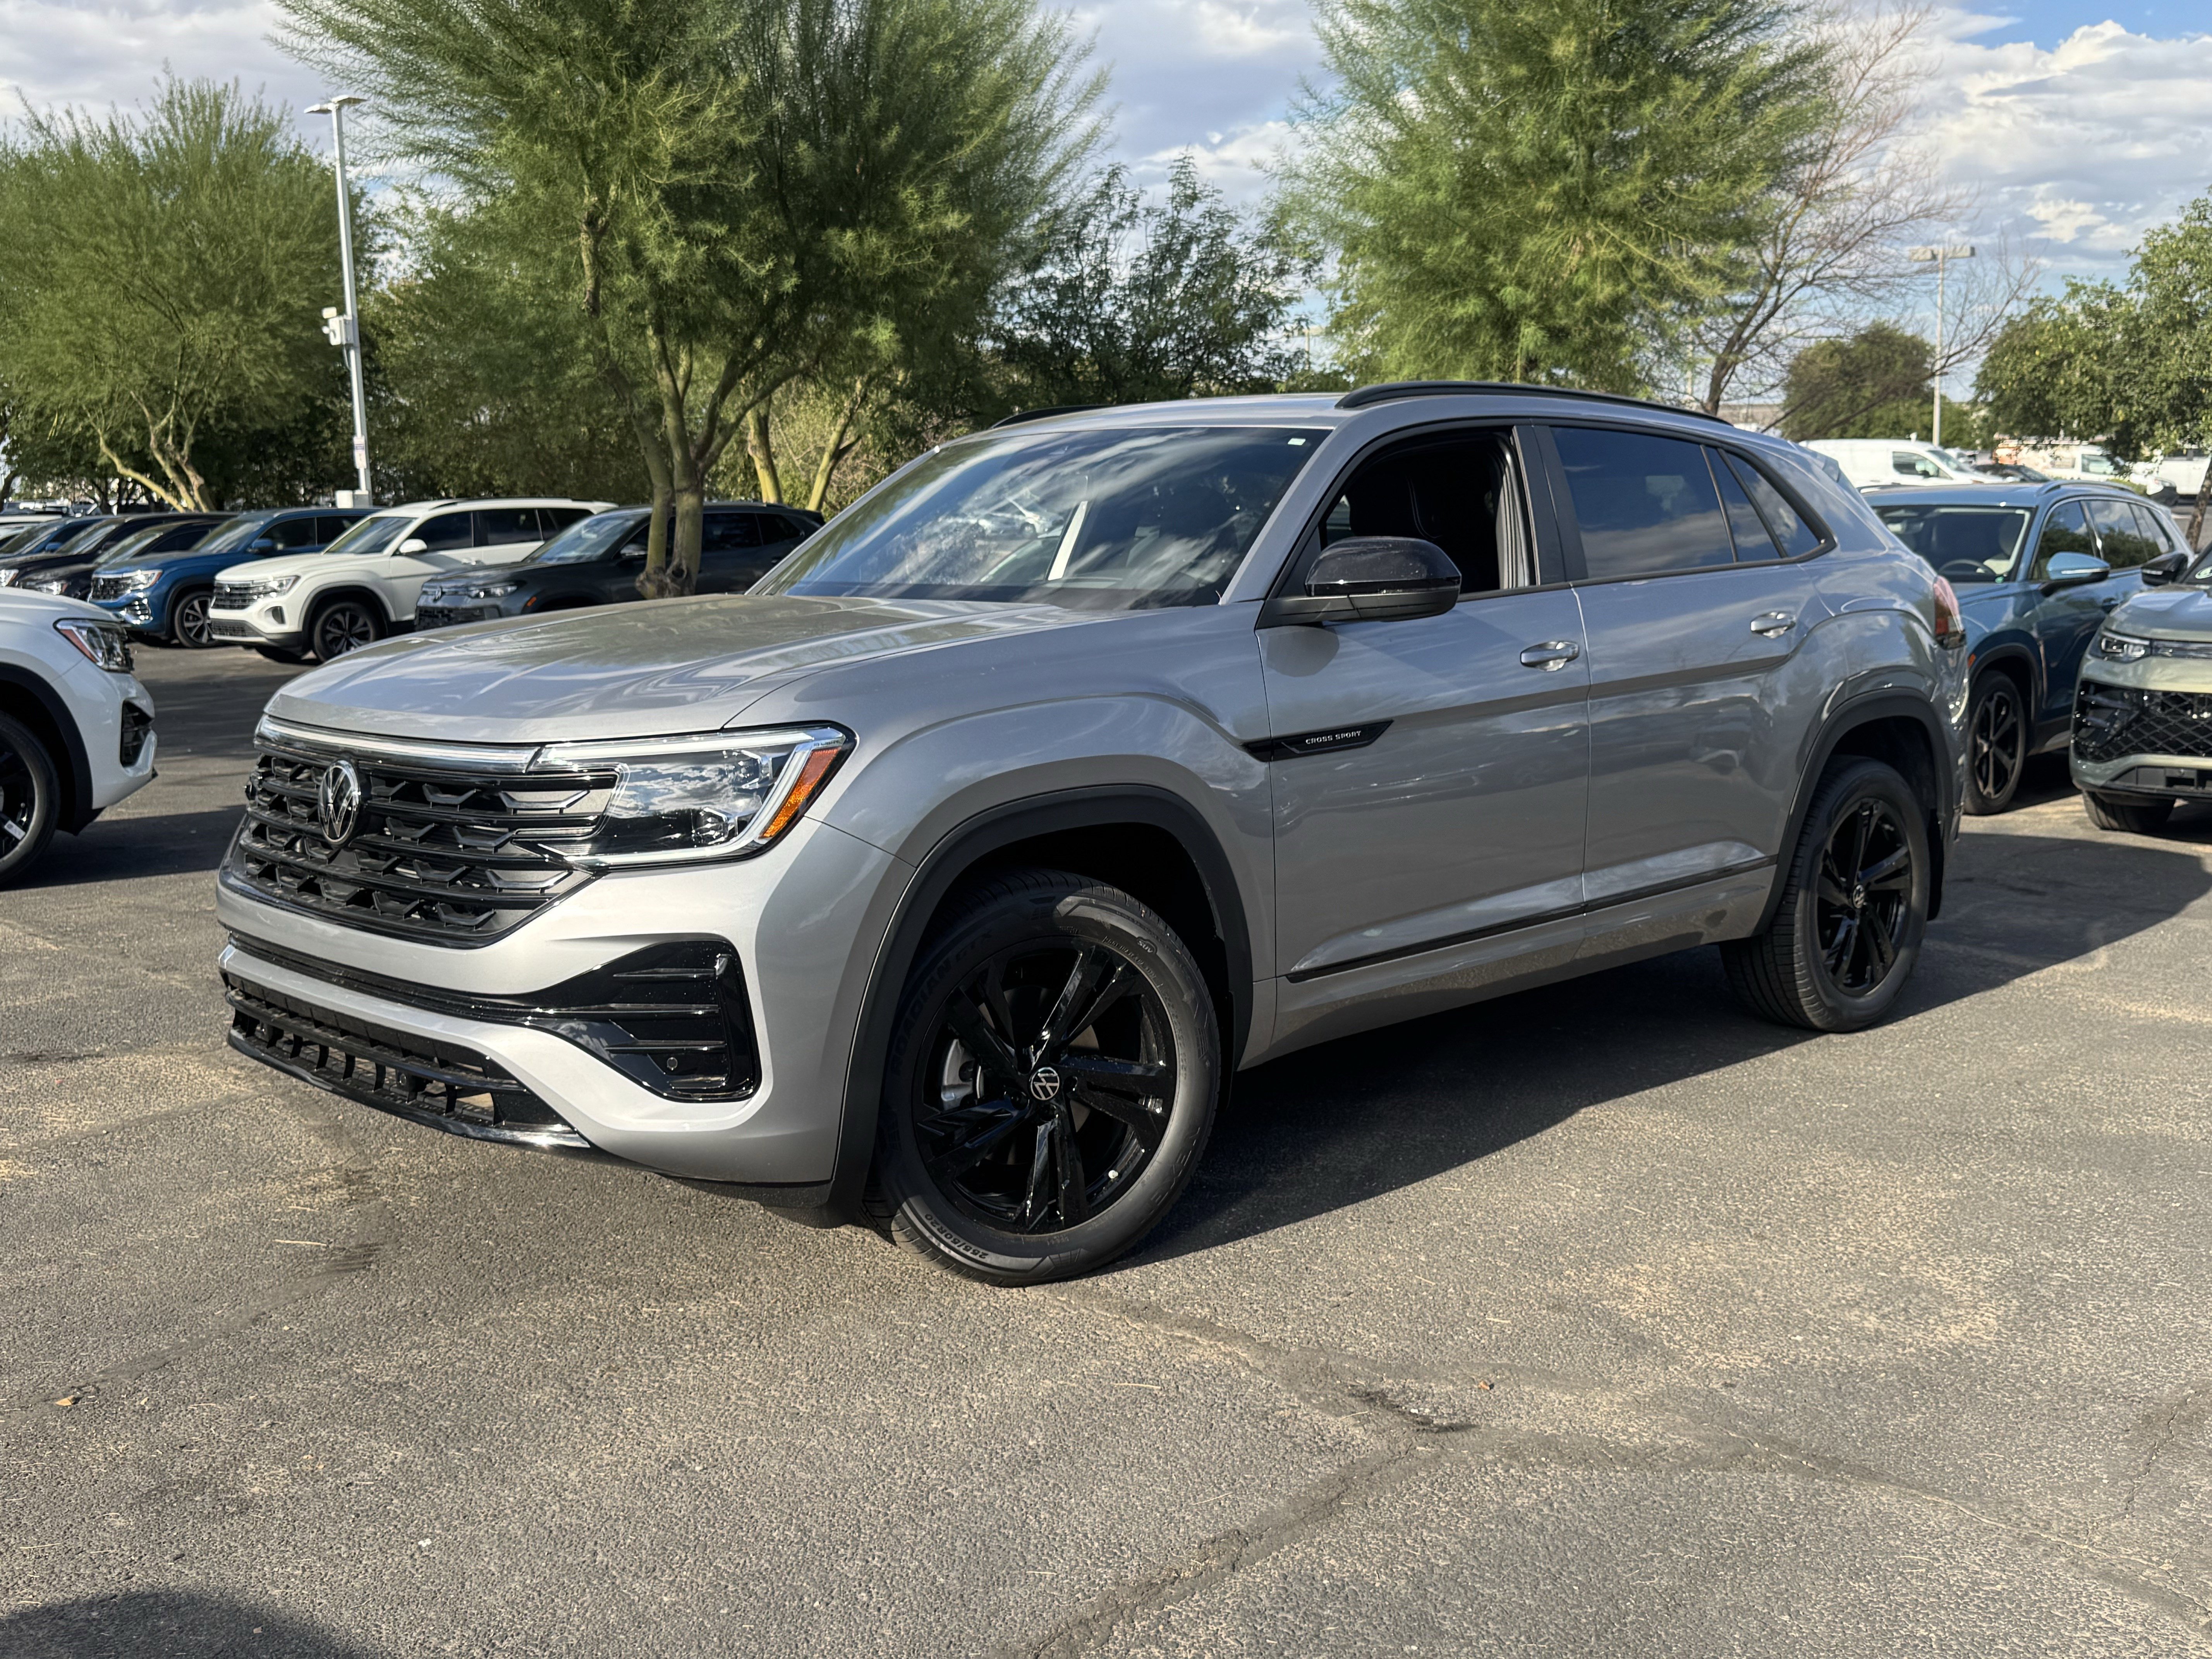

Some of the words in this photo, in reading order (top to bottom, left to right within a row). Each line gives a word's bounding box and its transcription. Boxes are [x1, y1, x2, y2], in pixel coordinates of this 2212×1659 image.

[1306, 735, 1333, 744] CROSS
[1335, 730, 1361, 740] SPORT
[1137, 941, 1153, 953] SUV
[890, 958, 951, 1076] ROADIAN
[925, 1214, 989, 1259] 255/50R20
